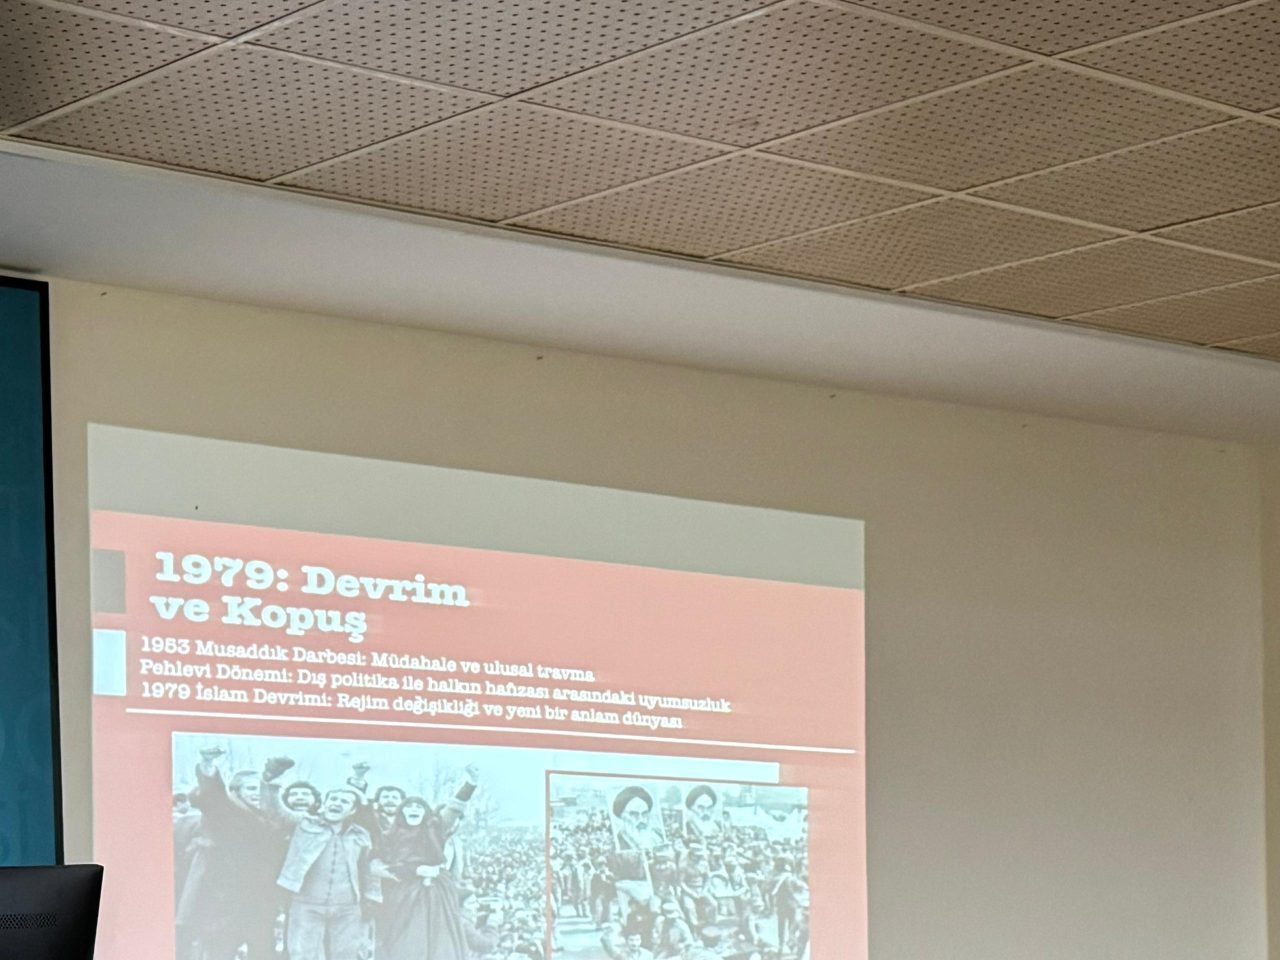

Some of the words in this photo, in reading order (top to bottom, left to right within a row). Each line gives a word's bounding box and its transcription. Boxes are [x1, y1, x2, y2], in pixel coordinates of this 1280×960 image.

[155, 551, 289, 592] 1979:
[301, 565, 470, 607] Devrim
[149, 595, 210, 622] ve
[221, 595, 368, 643] Kopuş
[139, 658, 213, 680] Pehlevi
[216, 663, 293, 684] Dönemi:
[297, 671, 327, 689] Dış
[331, 672, 400, 692] politika
[402, 674, 424, 692] ile
[427, 676, 482, 695] halkın
[195, 639, 289, 661] Musaddık
[292, 648, 367, 667] Darbesi:
[371, 652, 457, 673] Müdahale
[460, 661, 481, 674] ve
[483, 660, 534, 678] ulusal
[537, 665, 596, 683] travma
[142, 681, 191, 700] 1979
[195, 681, 249, 703] İslam
[253, 688, 332, 708] Devrimi:
[337, 693, 390, 713] Rejim
[393, 696, 480, 718] değişikliği
[482, 703, 504, 717] ve
[505, 703, 543, 721] yeni
[544, 704, 569, 721] bir
[571, 708, 620, 725] anlam
